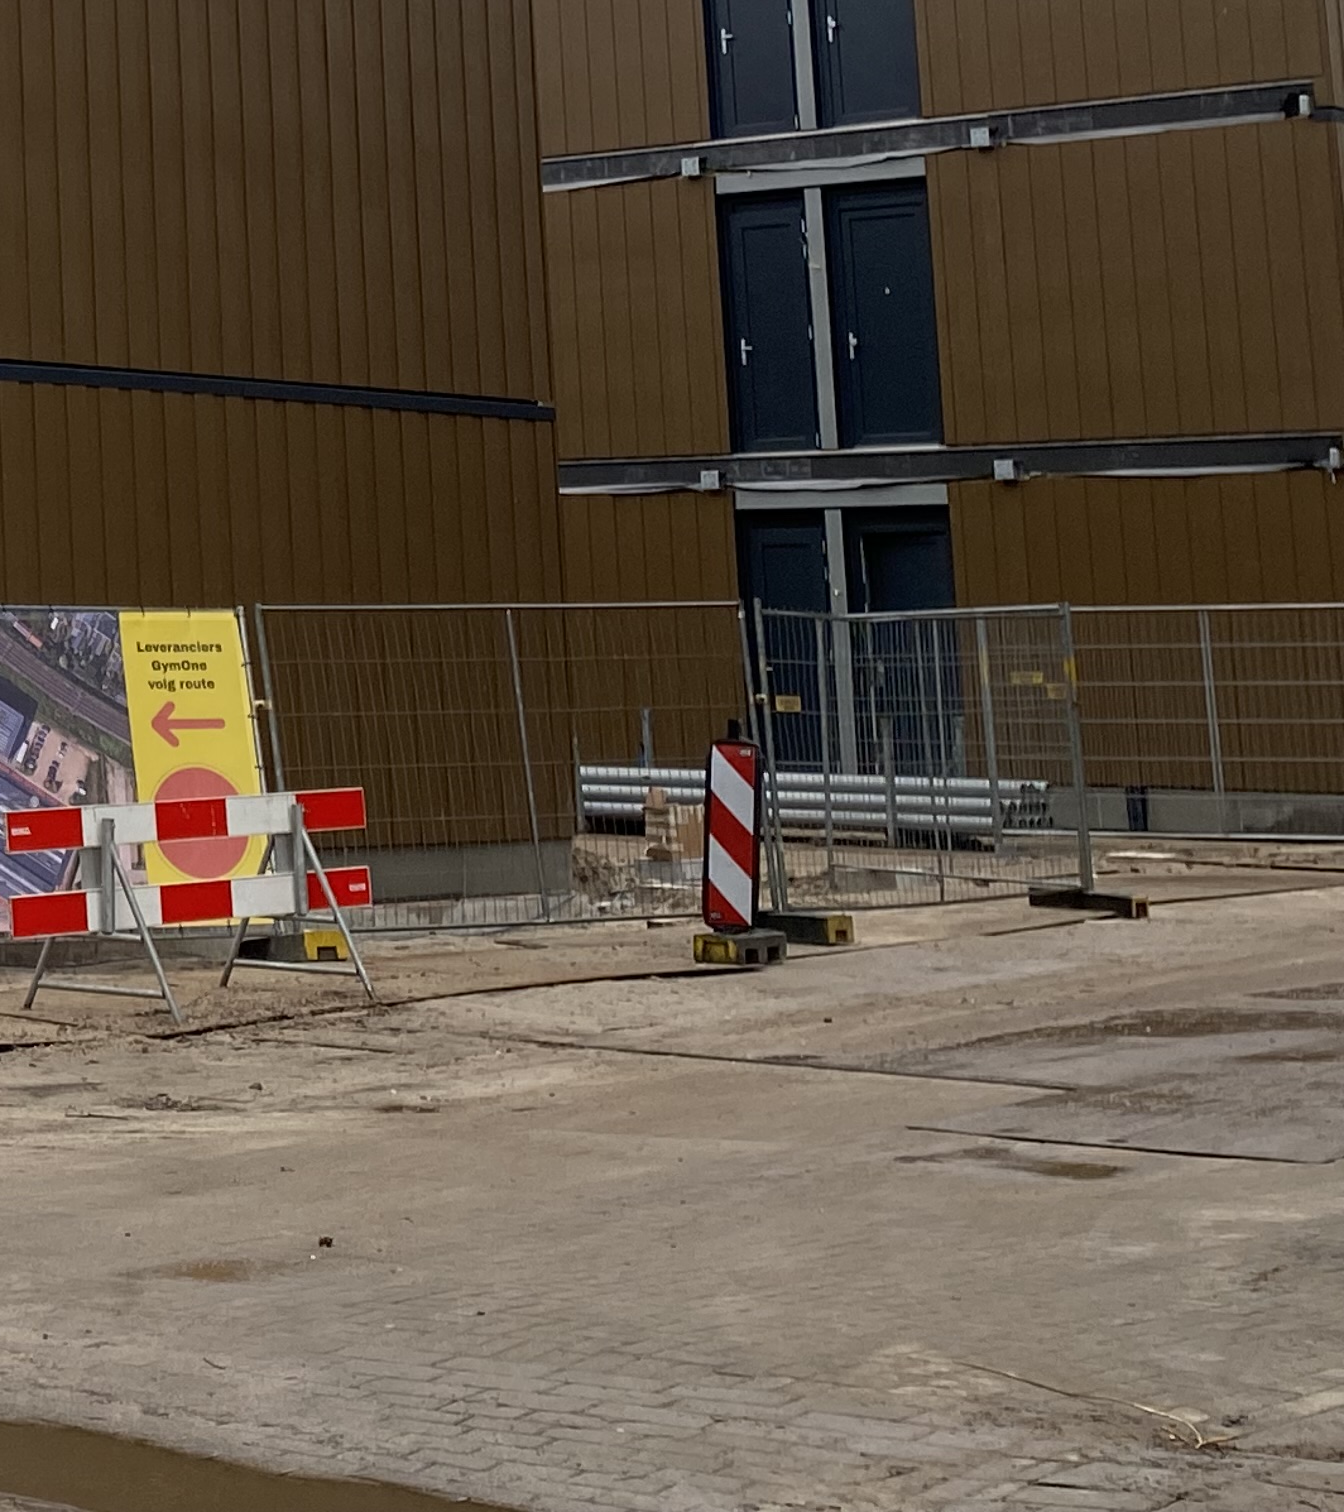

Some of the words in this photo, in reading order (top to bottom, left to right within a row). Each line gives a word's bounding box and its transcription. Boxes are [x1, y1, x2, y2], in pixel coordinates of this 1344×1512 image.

[135, 640, 223, 653] Leveranciers
[151, 659, 208, 674] GymOne
[148, 678, 177, 693] volg
[179, 678, 216, 690] route
